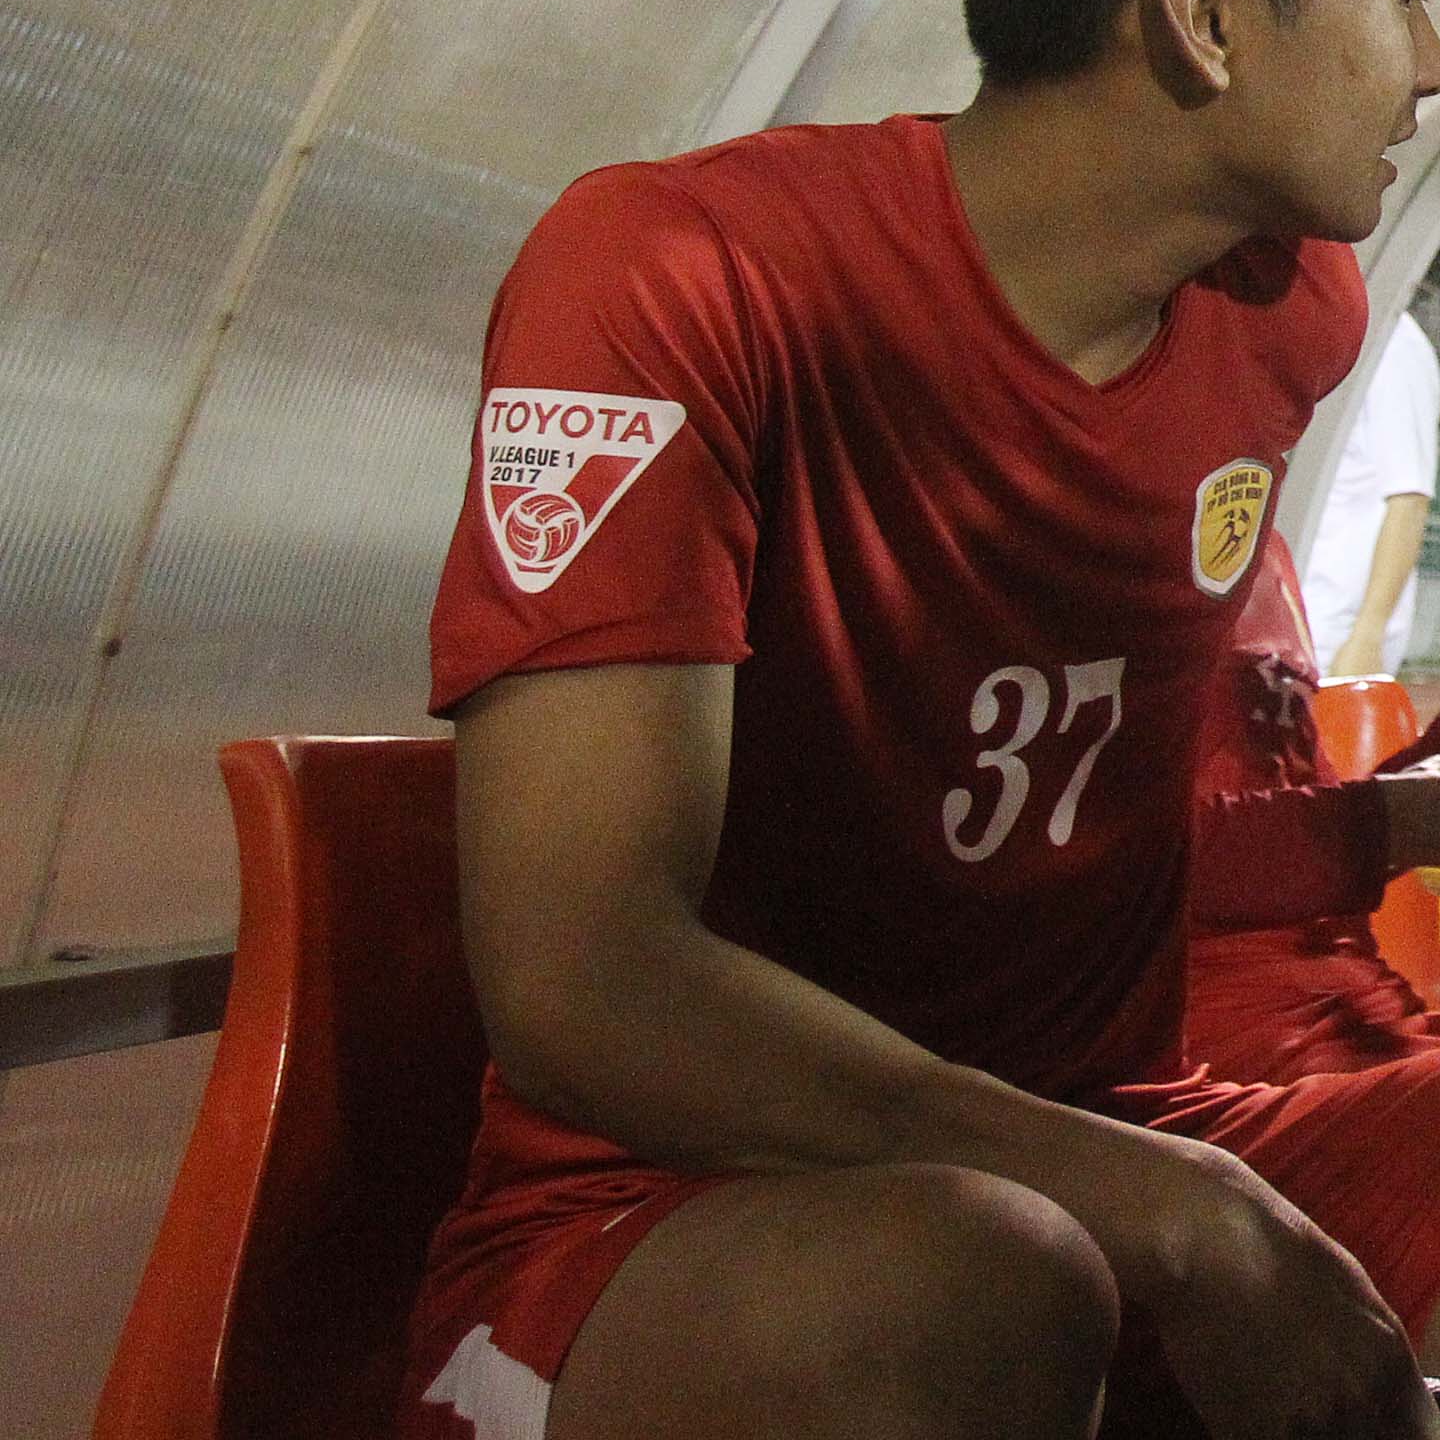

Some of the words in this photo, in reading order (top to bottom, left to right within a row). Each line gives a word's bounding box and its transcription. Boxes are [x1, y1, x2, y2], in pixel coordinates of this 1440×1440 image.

[490, 401, 655, 445] TOYOTA
[490, 466, 541, 484] 2017
[565, 451, 576, 469] 1
[942, 657, 1126, 863] 37
